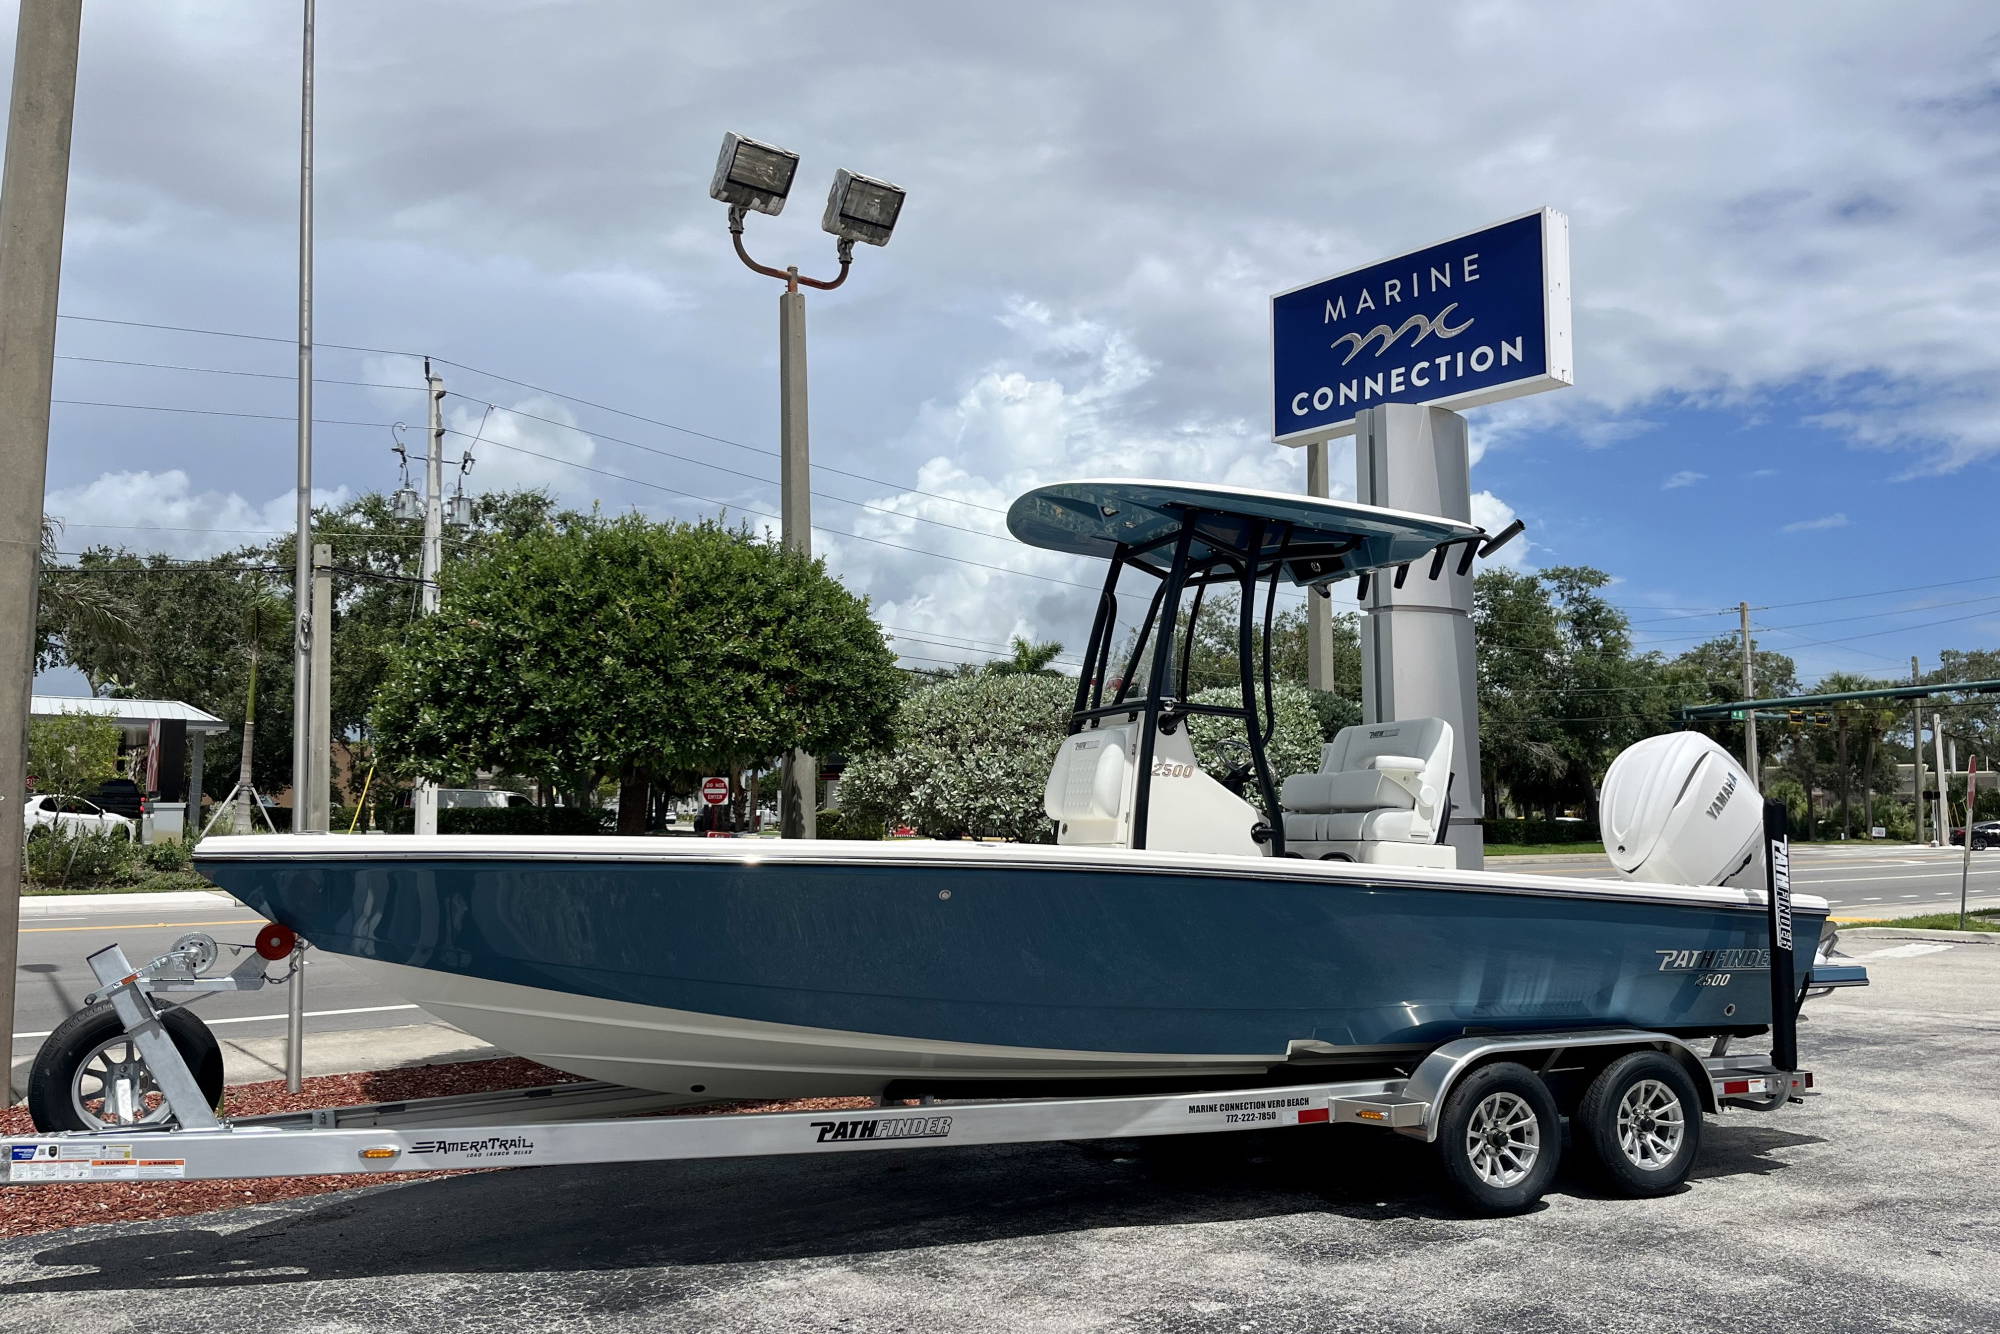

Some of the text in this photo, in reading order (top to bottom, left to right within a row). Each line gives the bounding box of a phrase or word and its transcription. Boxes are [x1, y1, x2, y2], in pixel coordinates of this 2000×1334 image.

[1324, 253, 1480, 324] MARINE
[1291, 336, 1523, 416] CONNECTION
[1151, 763, 1194, 778] 2500
[1706, 772, 1738, 820] YAMAHA
[1771, 834, 1793, 951] PATHFINDER
[1656, 949, 1771, 971] PATHFINDE
[1695, 974, 1731, 987] 2500
[1188, 1097, 1310, 1114] MARINE CONNECTION VERO BEACH
[1226, 1111, 1277, 1123] 772-222-7850
[810, 1116, 952, 1143] PATHFINDER
